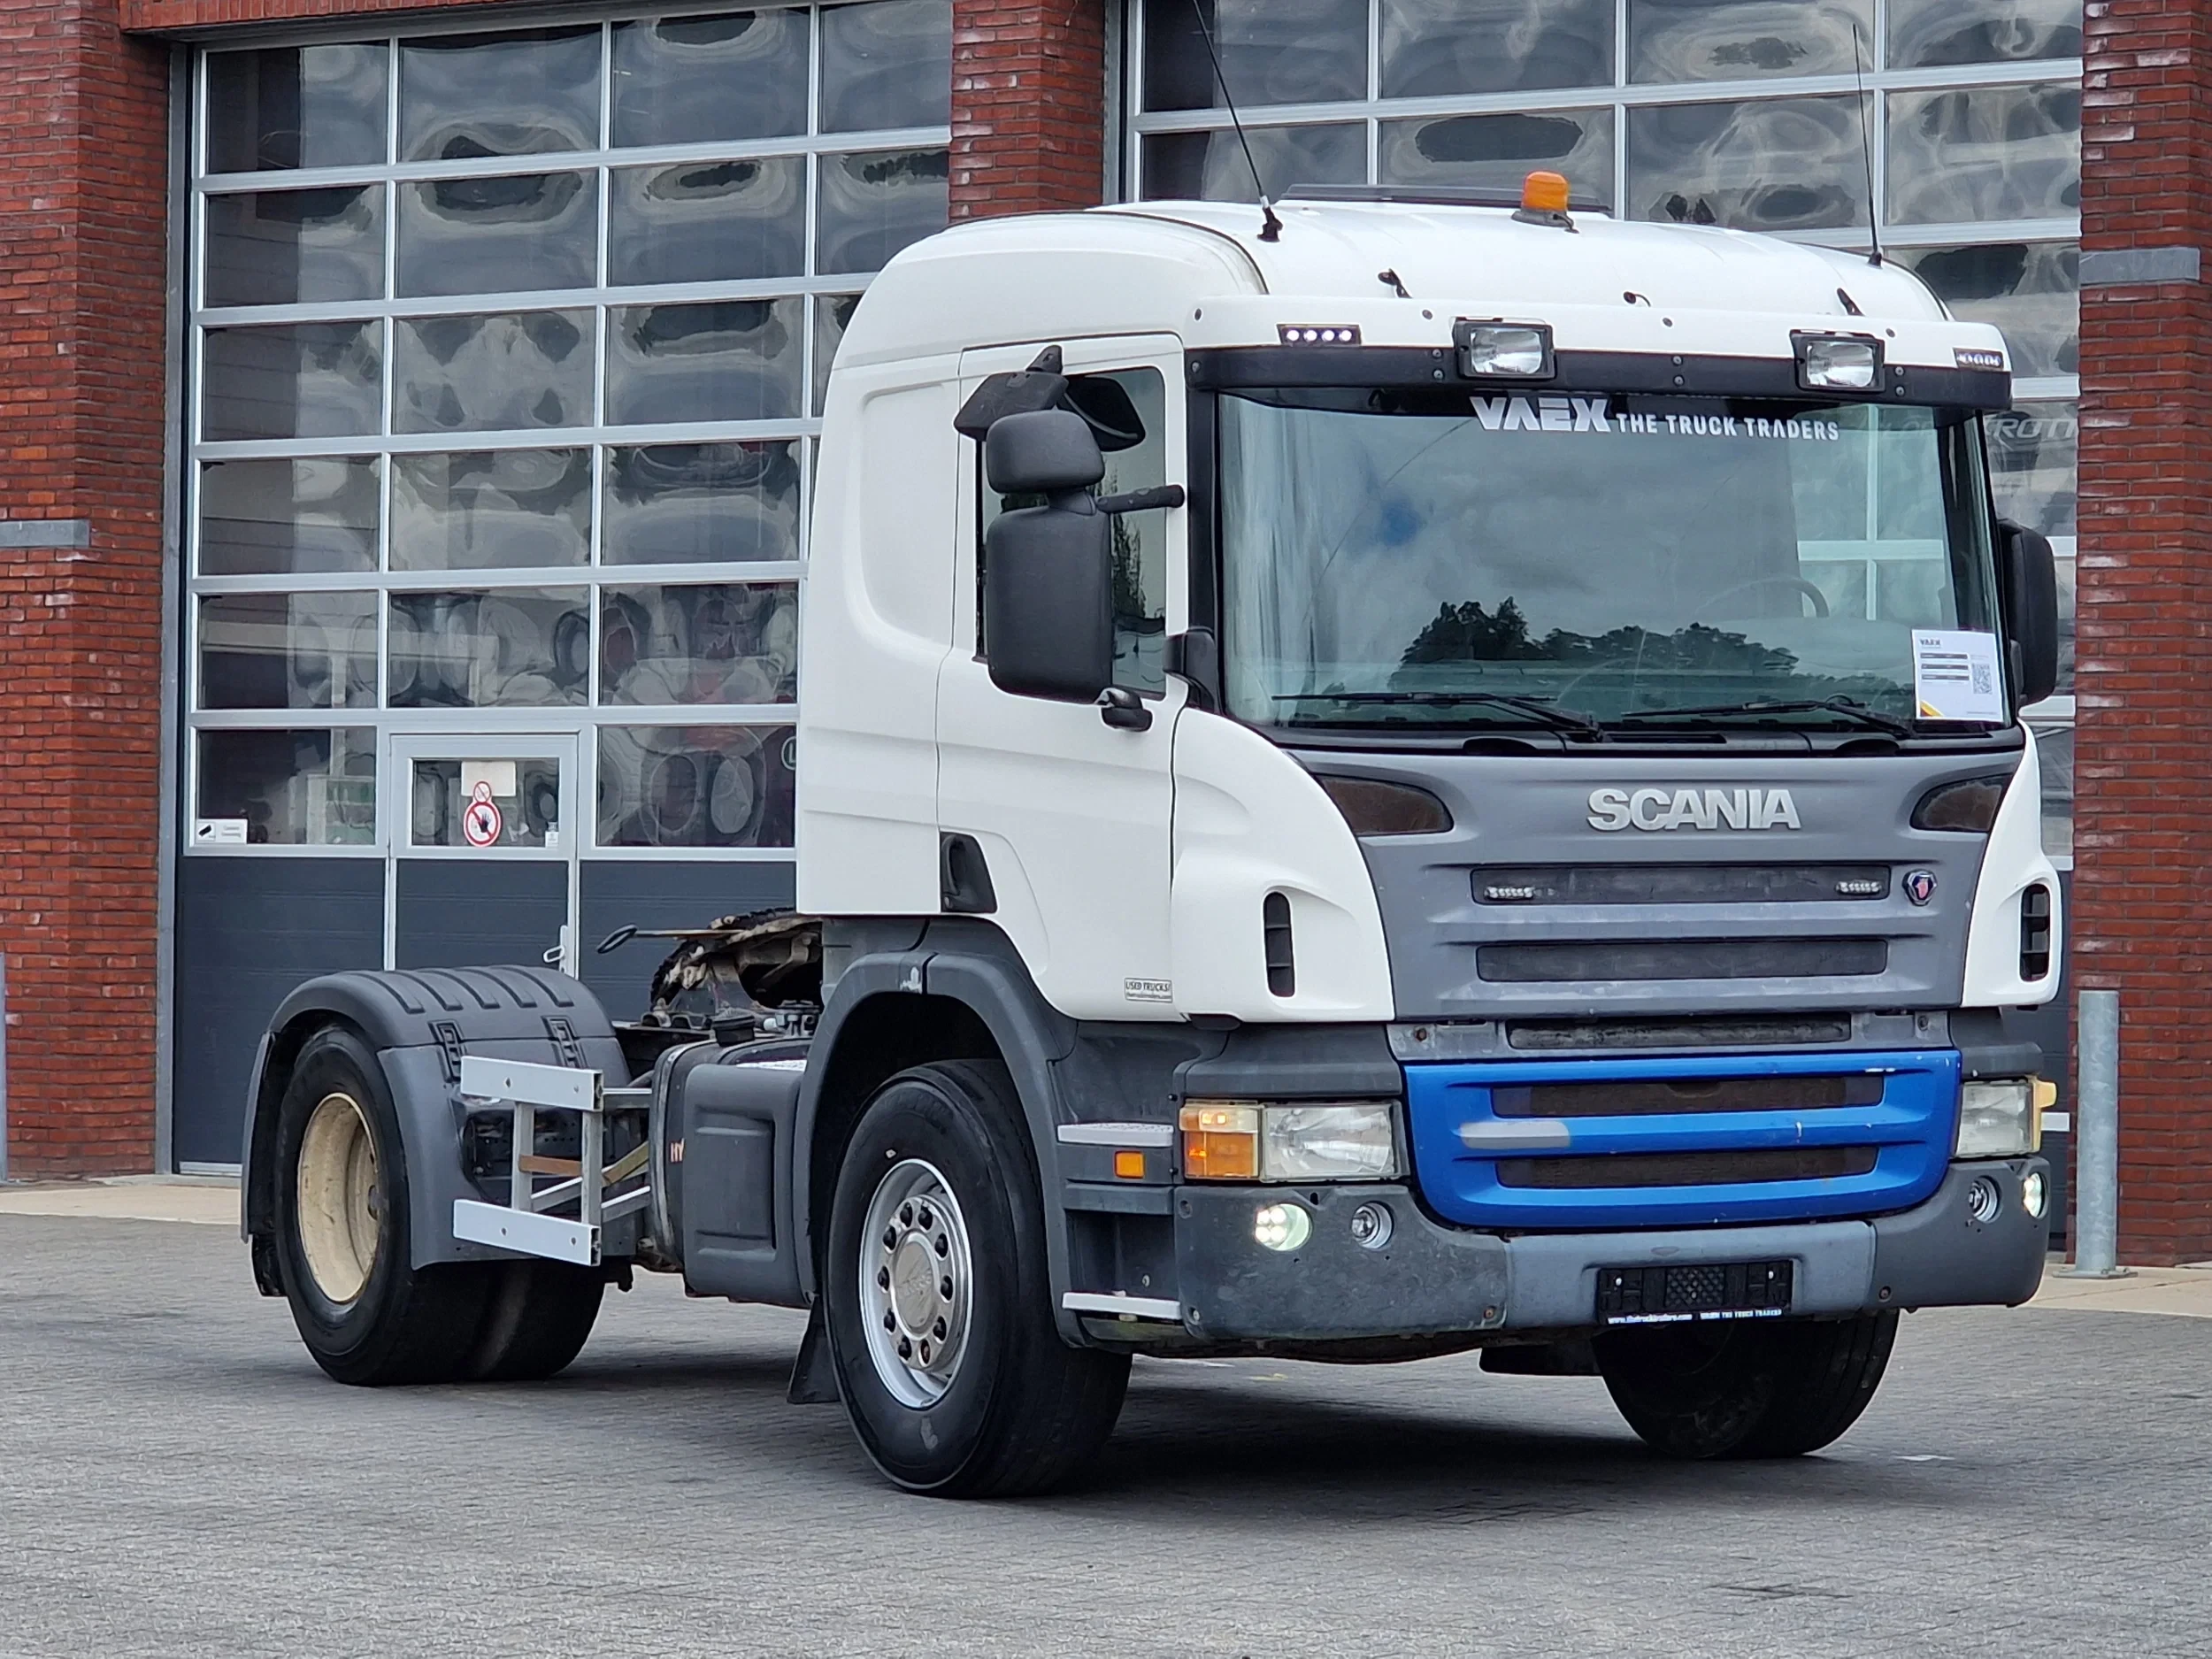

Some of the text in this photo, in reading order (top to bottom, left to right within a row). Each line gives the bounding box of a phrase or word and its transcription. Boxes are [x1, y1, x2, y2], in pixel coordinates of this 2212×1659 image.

[1470, 396, 1839, 441] VAEX THE TRUCK TRADERS
[1586, 788, 1801, 831] SCANIA
[1125, 981, 1142, 990] USED
